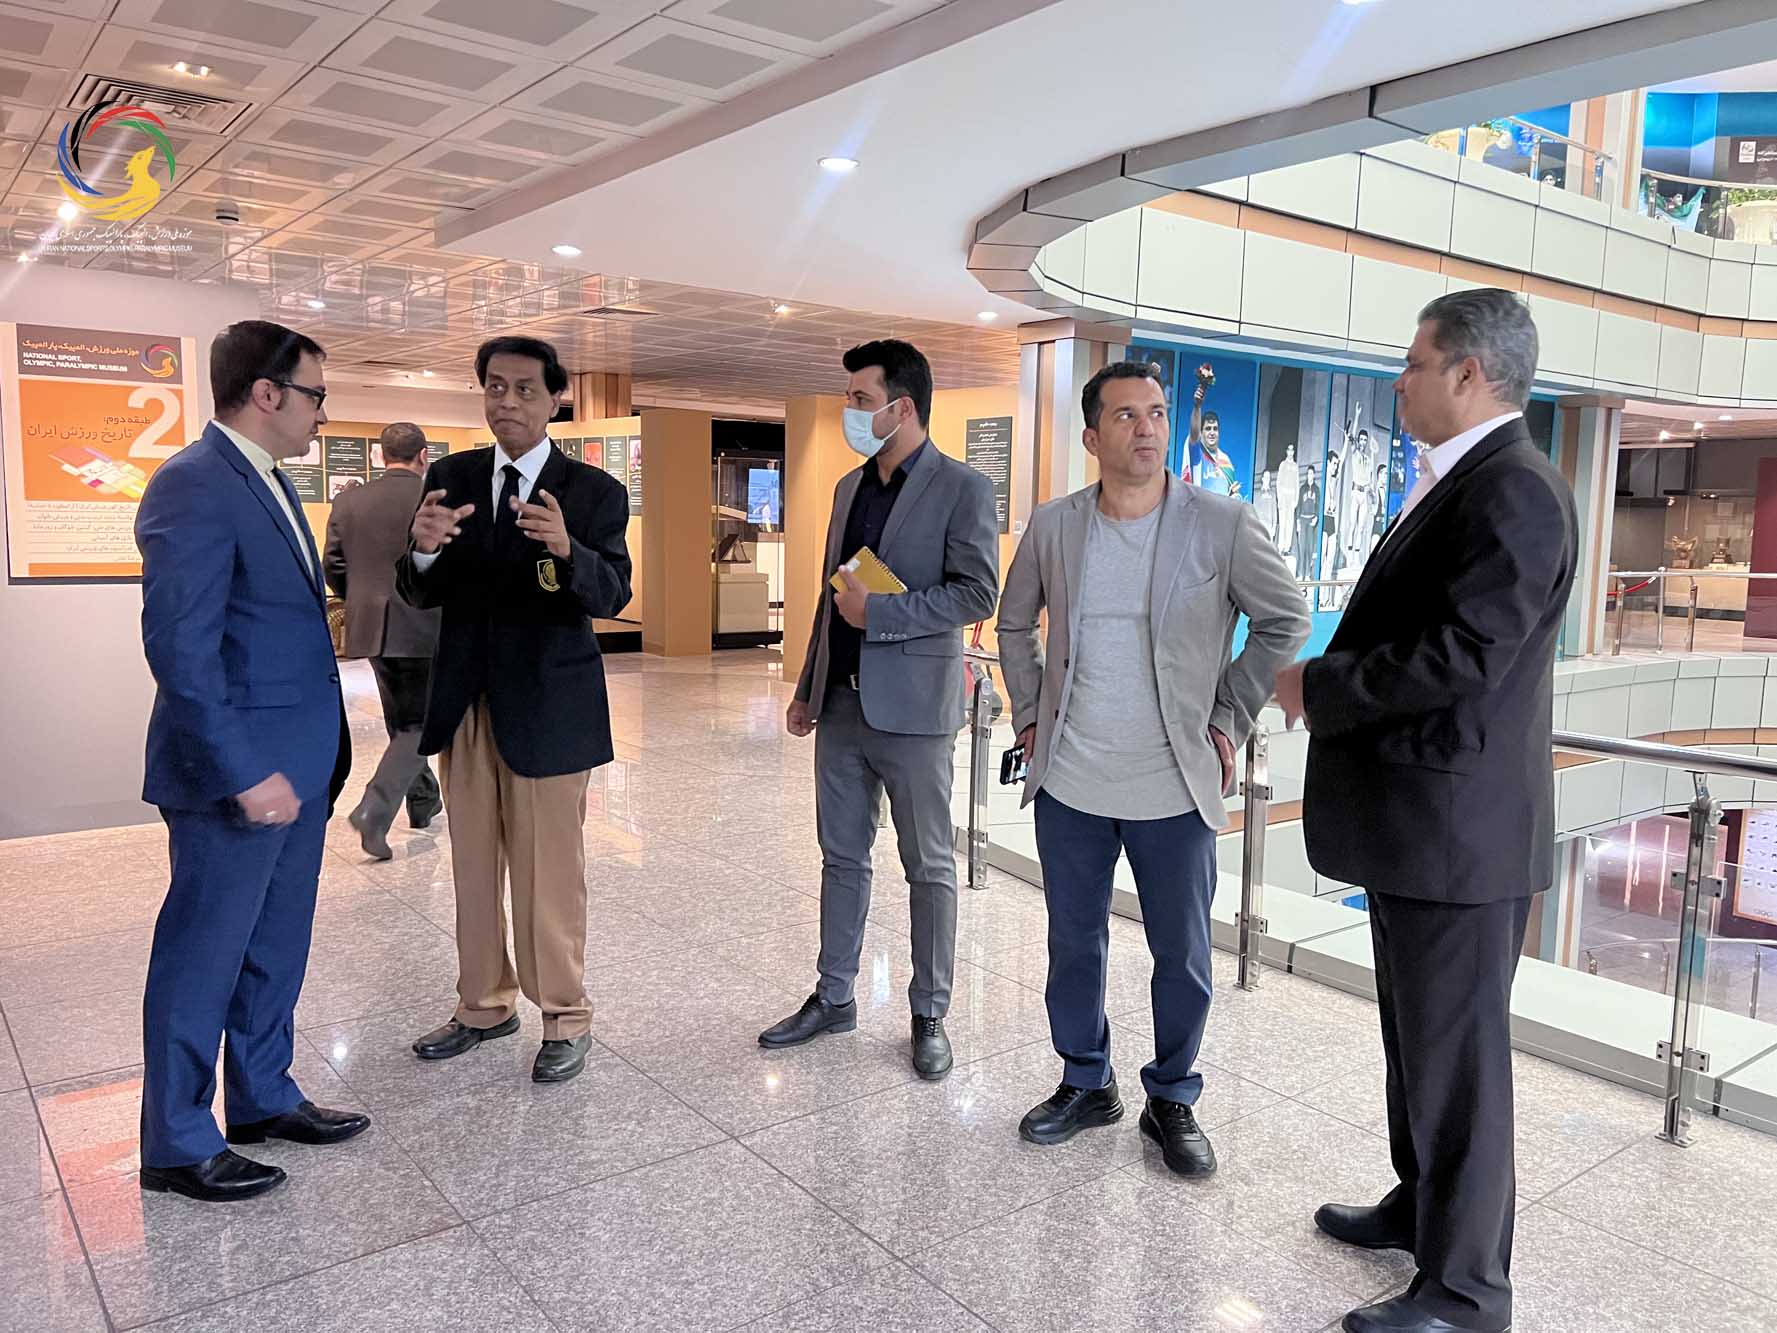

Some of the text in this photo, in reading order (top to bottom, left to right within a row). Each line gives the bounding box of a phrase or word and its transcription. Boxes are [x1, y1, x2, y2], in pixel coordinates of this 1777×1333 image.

[23, 351, 57, 360] NATIONAL
[23, 359, 128, 372] OLYMPIC, PARALYMPIC MUSEUM
[127, 414, 152, 424] طبقه
[127, 386, 187, 459] 2
[27, 424, 133, 443] تاریخ ورزش ایران
